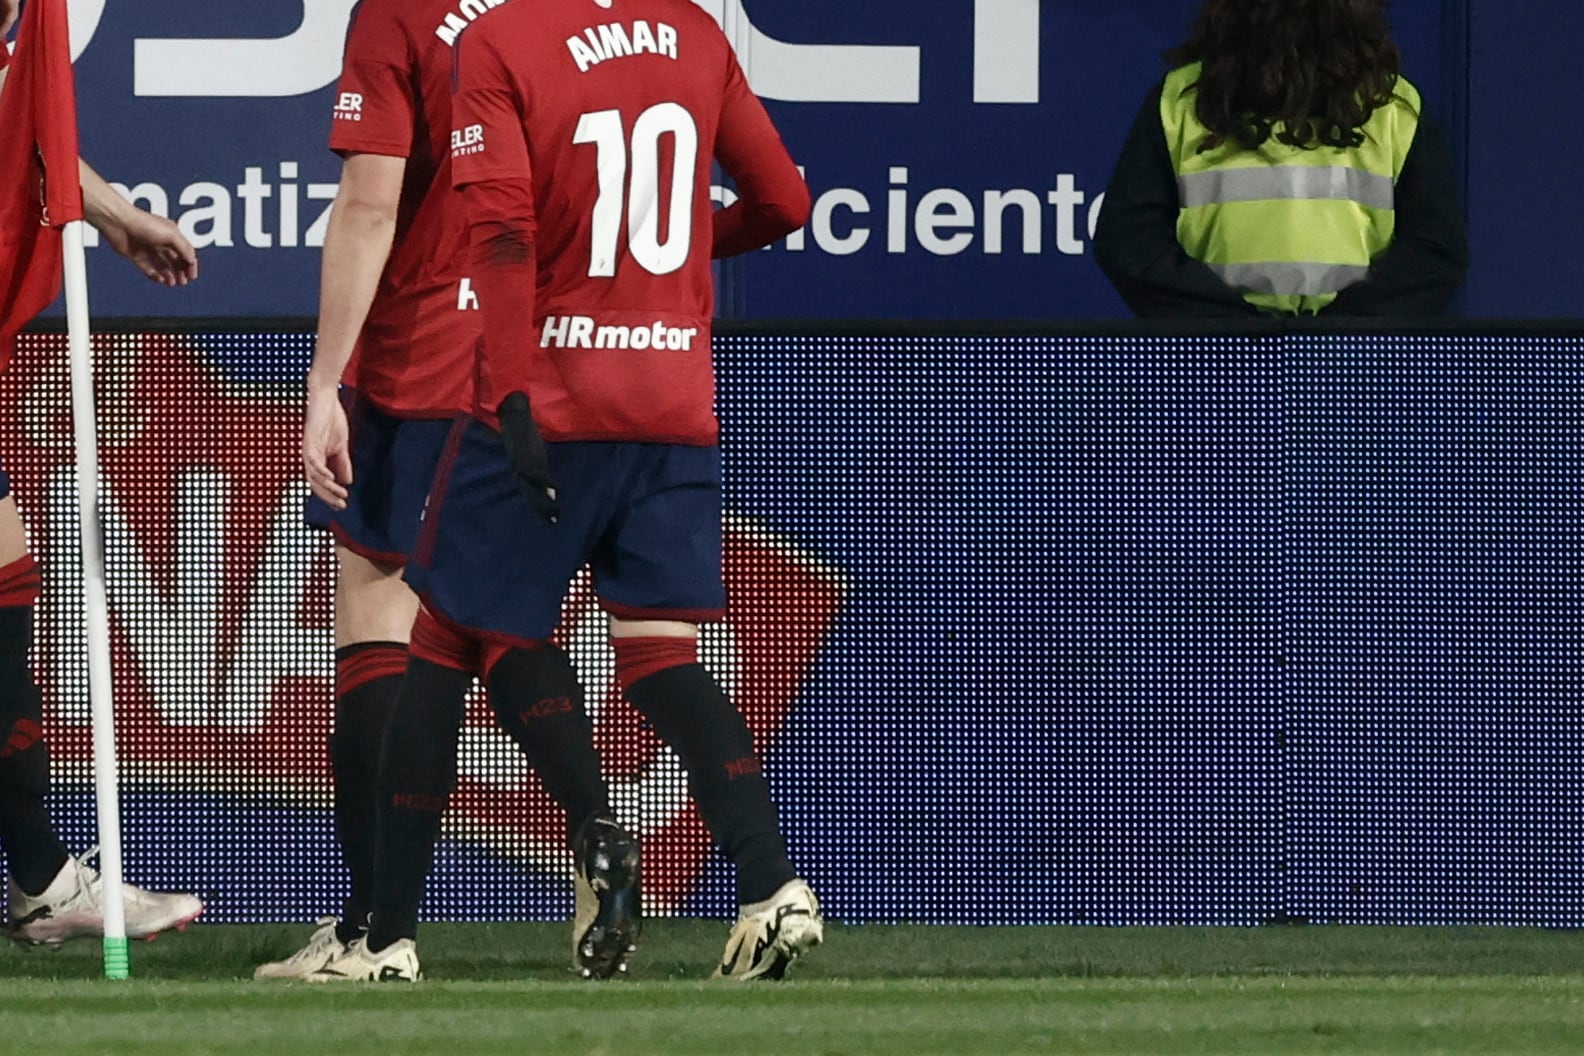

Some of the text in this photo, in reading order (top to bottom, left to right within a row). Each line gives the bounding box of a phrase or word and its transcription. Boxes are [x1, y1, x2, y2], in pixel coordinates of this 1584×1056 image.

[566, 20, 678, 73] AIMAR
[572, 102, 698, 277] 10
[539, 315, 698, 351] HRmotor
